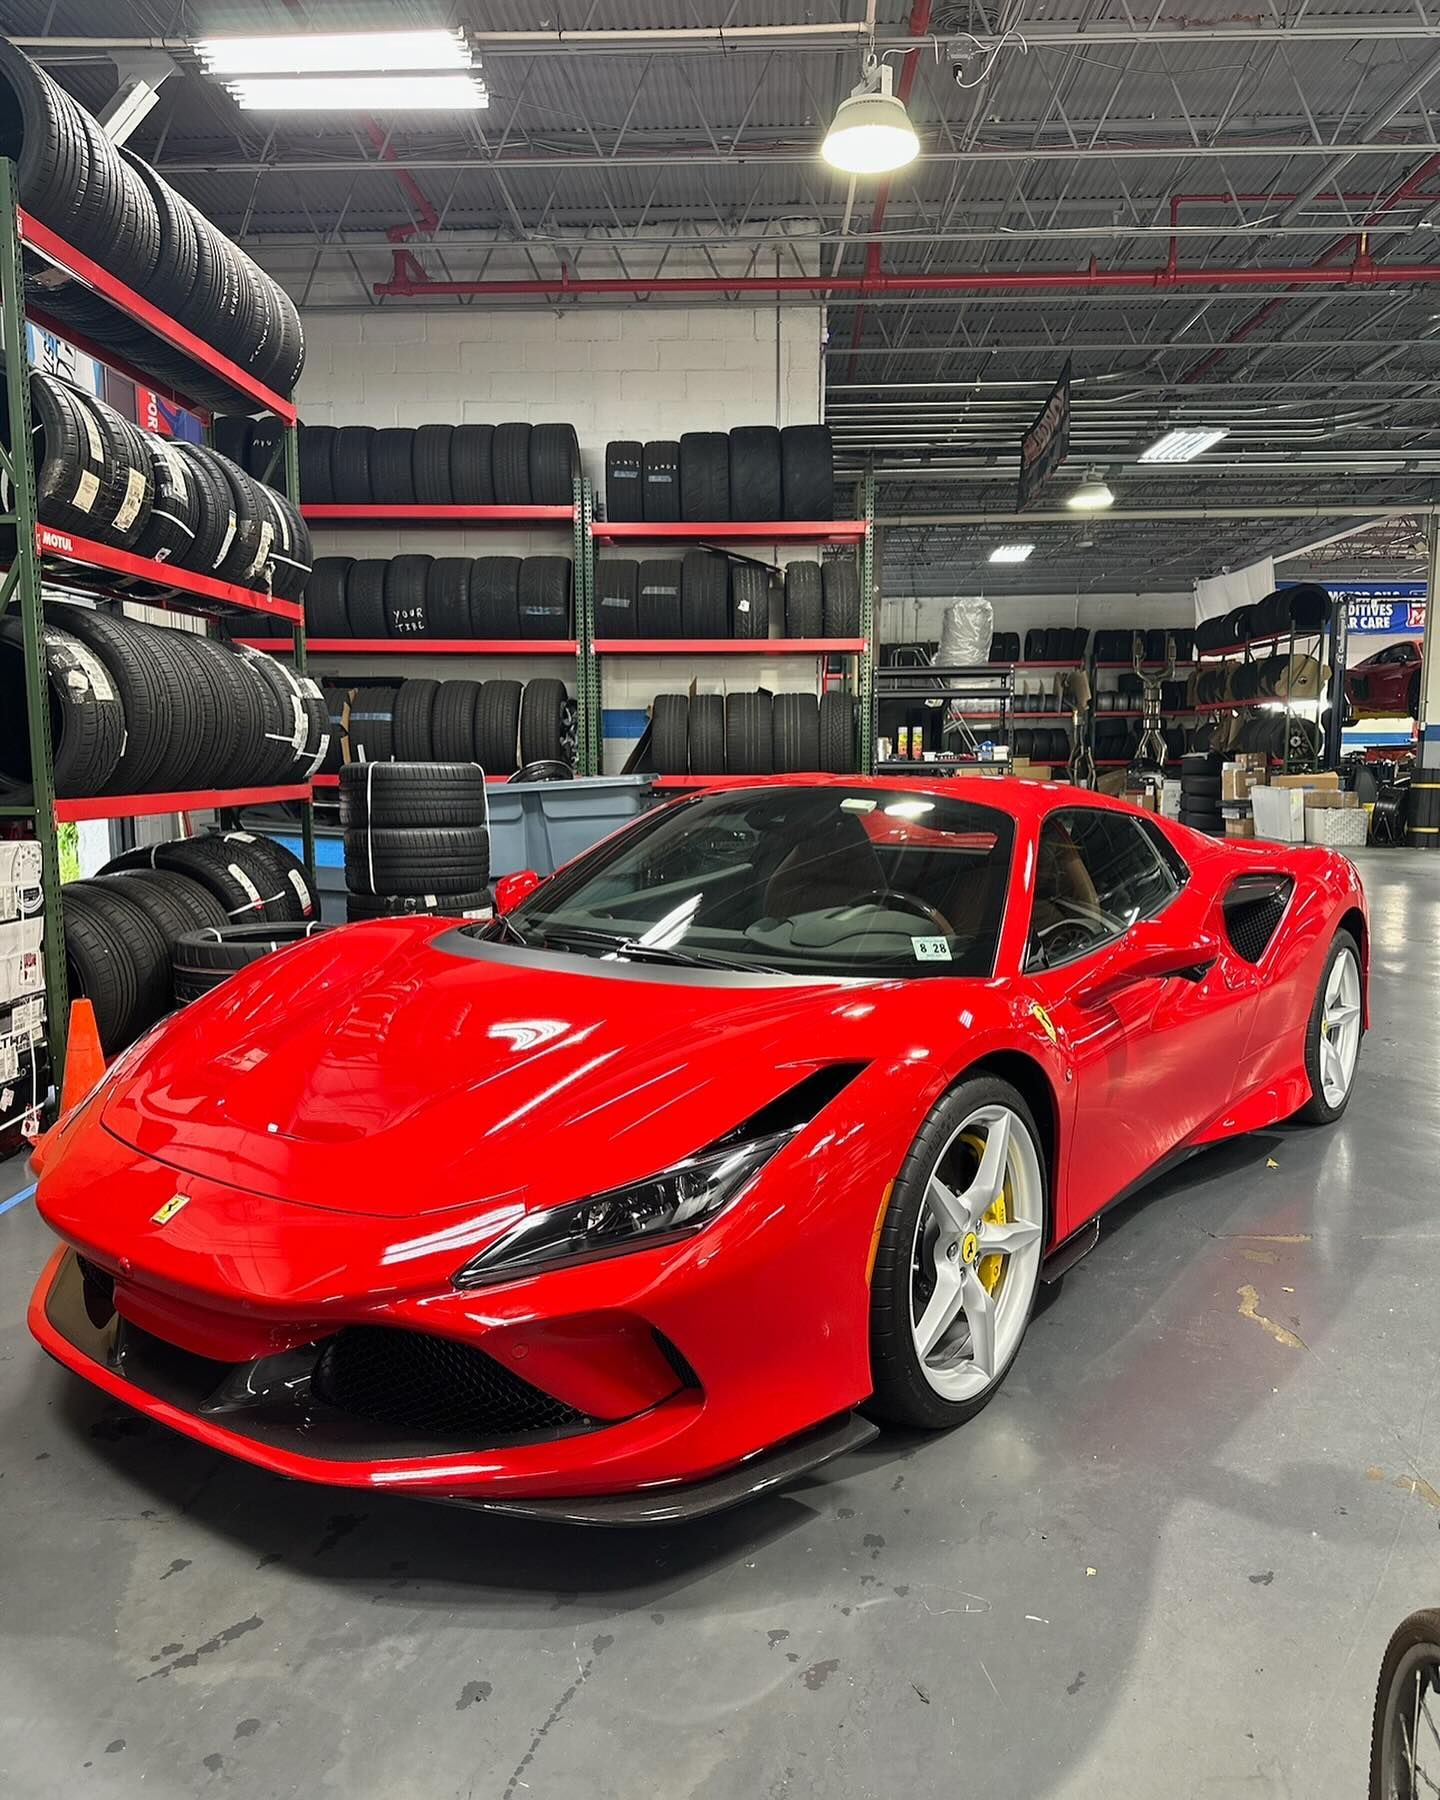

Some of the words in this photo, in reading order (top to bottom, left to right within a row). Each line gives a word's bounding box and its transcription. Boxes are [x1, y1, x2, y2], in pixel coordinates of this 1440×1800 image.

[43, 531, 74, 552] MOTUL
[393, 607, 424, 624] YOUR
[1348, 603, 1393, 616] DITIVES
[395, 620, 425, 633] TIRE
[1360, 616, 1391, 629] CARE
[920, 943, 927, 953] 8
[932, 943, 947, 953] 28
